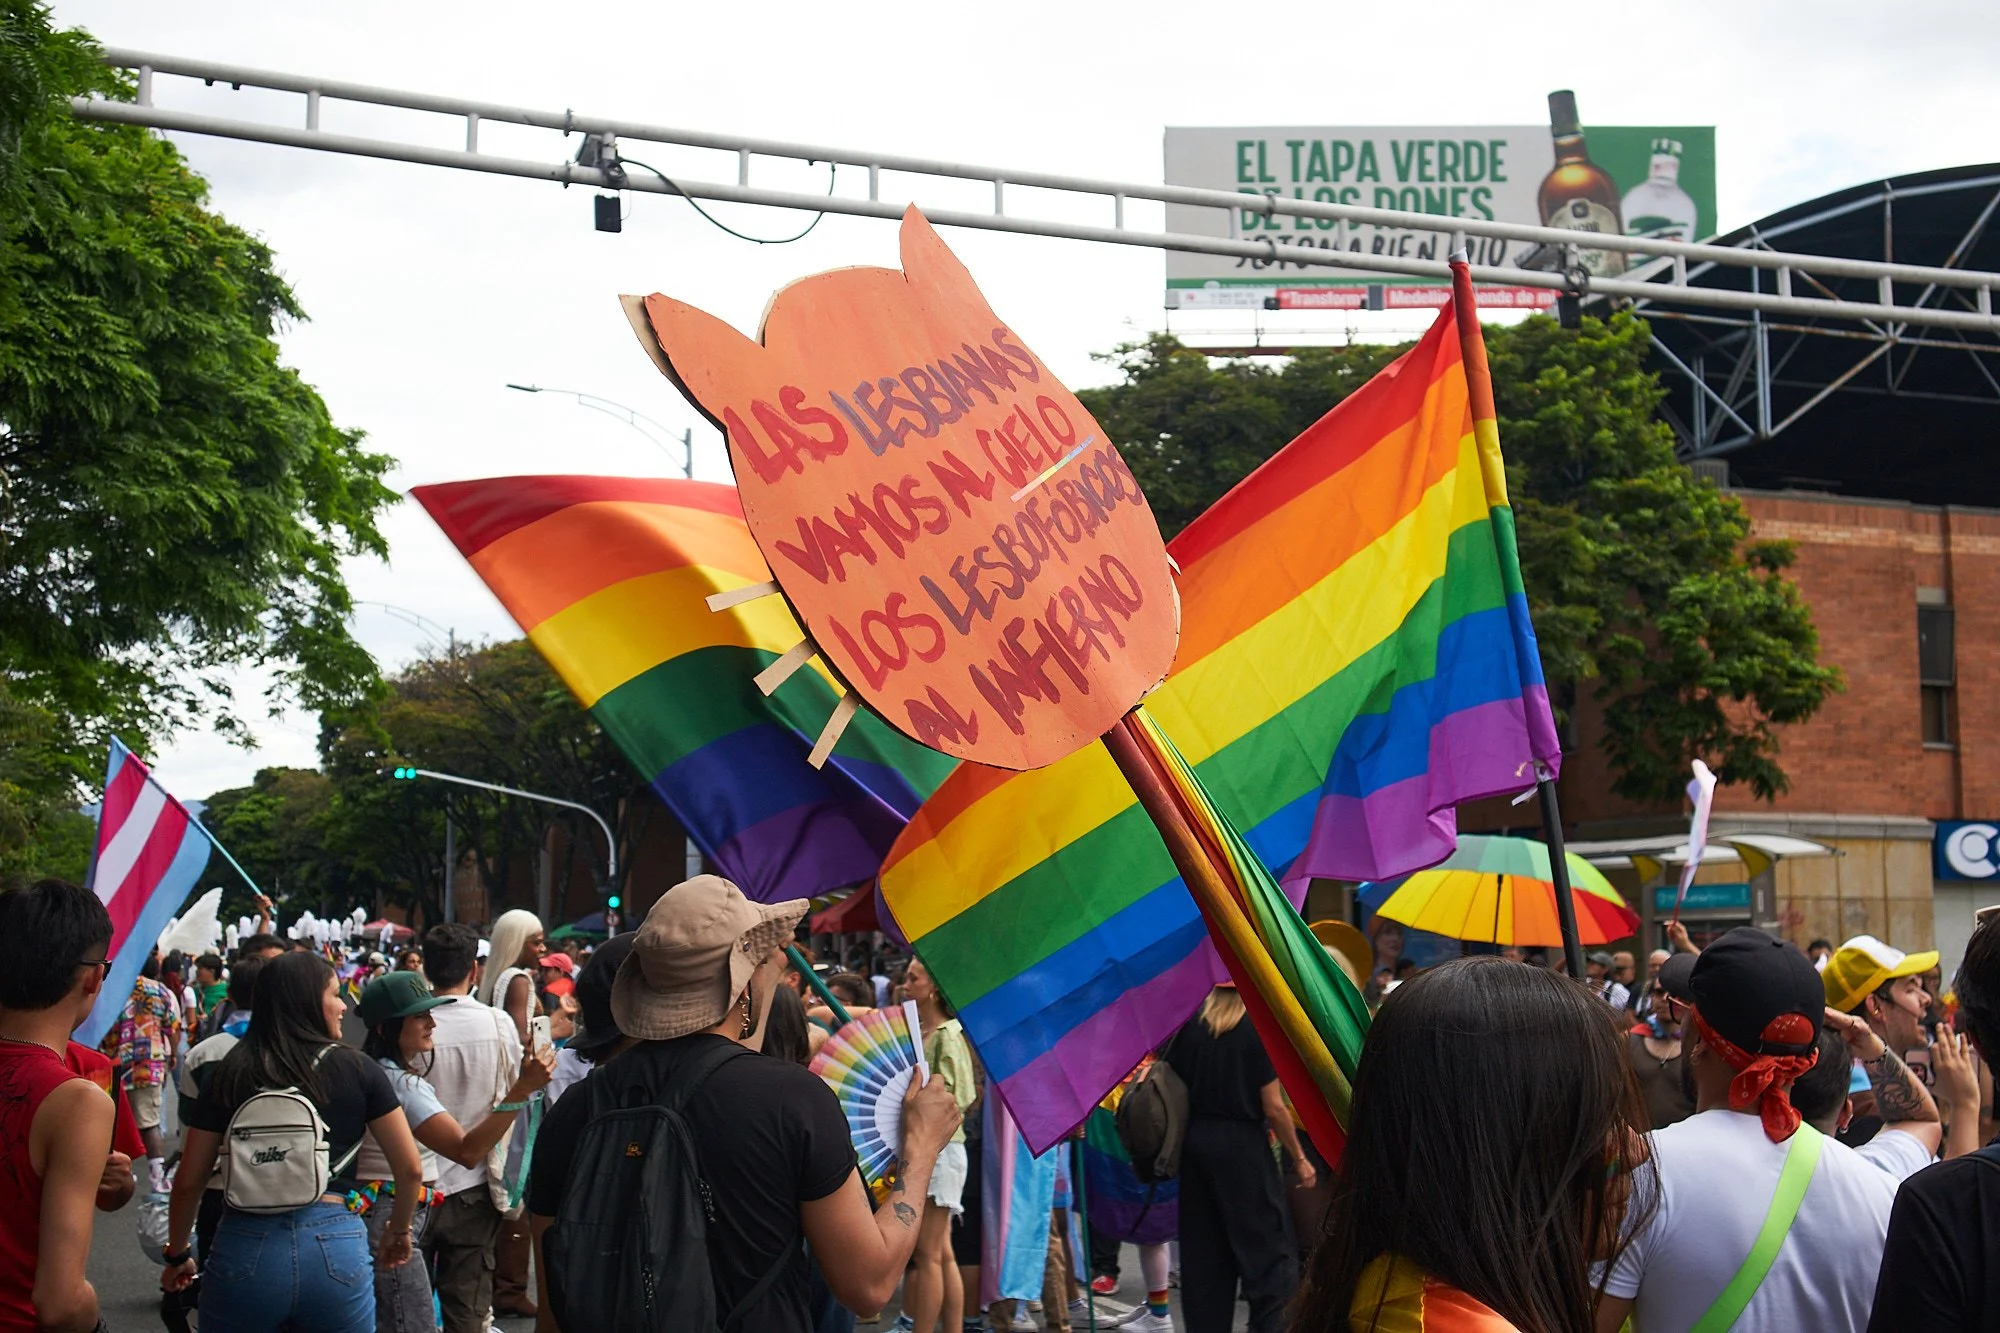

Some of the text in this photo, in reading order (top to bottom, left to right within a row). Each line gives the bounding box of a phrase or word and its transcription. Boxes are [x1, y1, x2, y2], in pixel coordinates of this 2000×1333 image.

[1237, 140, 1508, 182] EL TAPA VERDE
[723, 327, 1040, 485] LAS LESBIANAS
[775, 395, 1077, 584] VAMOS AL CIELO
[827, 592, 946, 691] LOS
[904, 554, 1144, 750] AL INFIERNO
